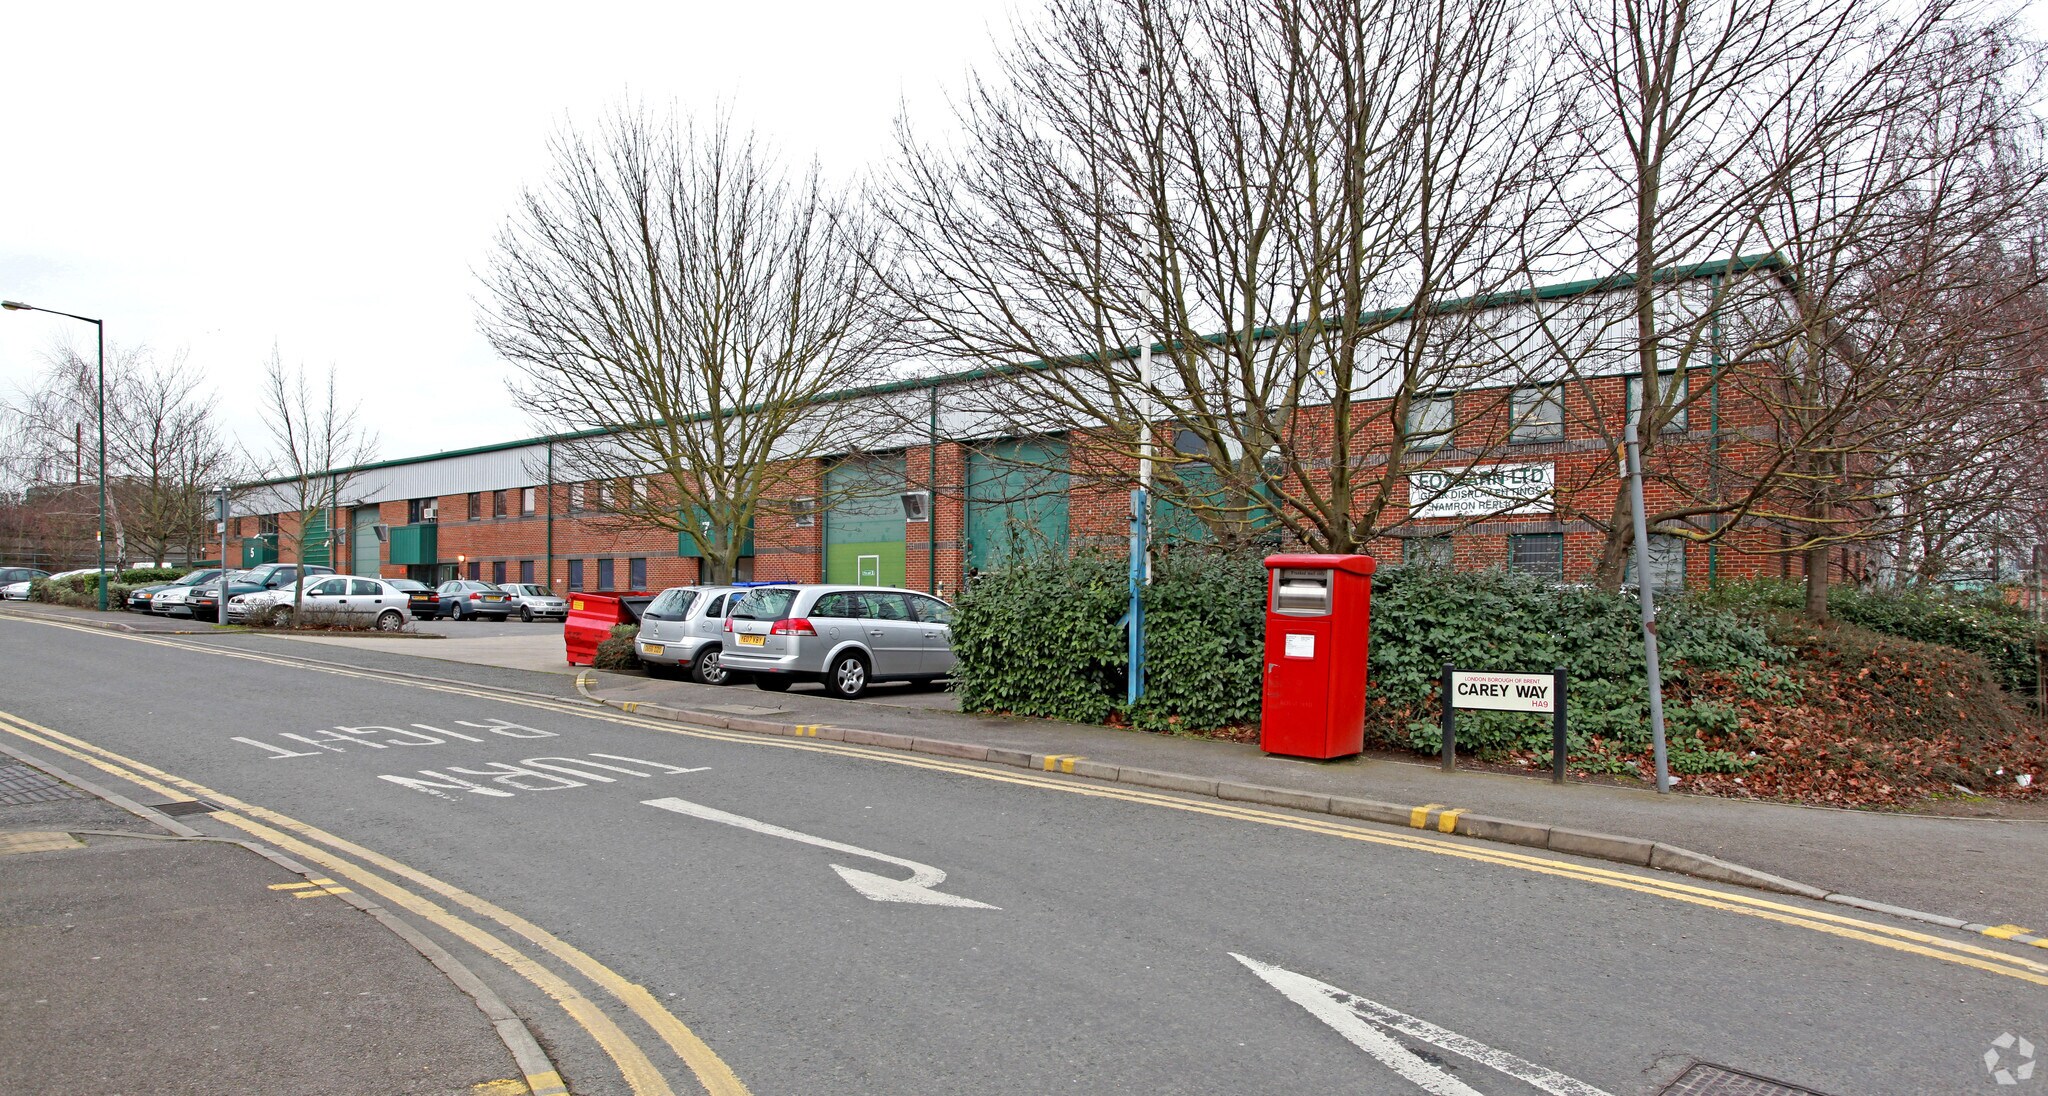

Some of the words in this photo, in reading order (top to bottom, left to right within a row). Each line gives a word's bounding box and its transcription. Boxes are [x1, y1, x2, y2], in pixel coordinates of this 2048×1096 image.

[1511, 468, 1544, 484] LTD
[1431, 502, 1475, 512] NAMRON
[702, 521, 710, 537] 7
[250, 547, 255, 558] 5
[1458, 683, 1509, 697] CAREY
[1516, 685, 1548, 699] WAY
[1532, 700, 1549, 708] HA9
